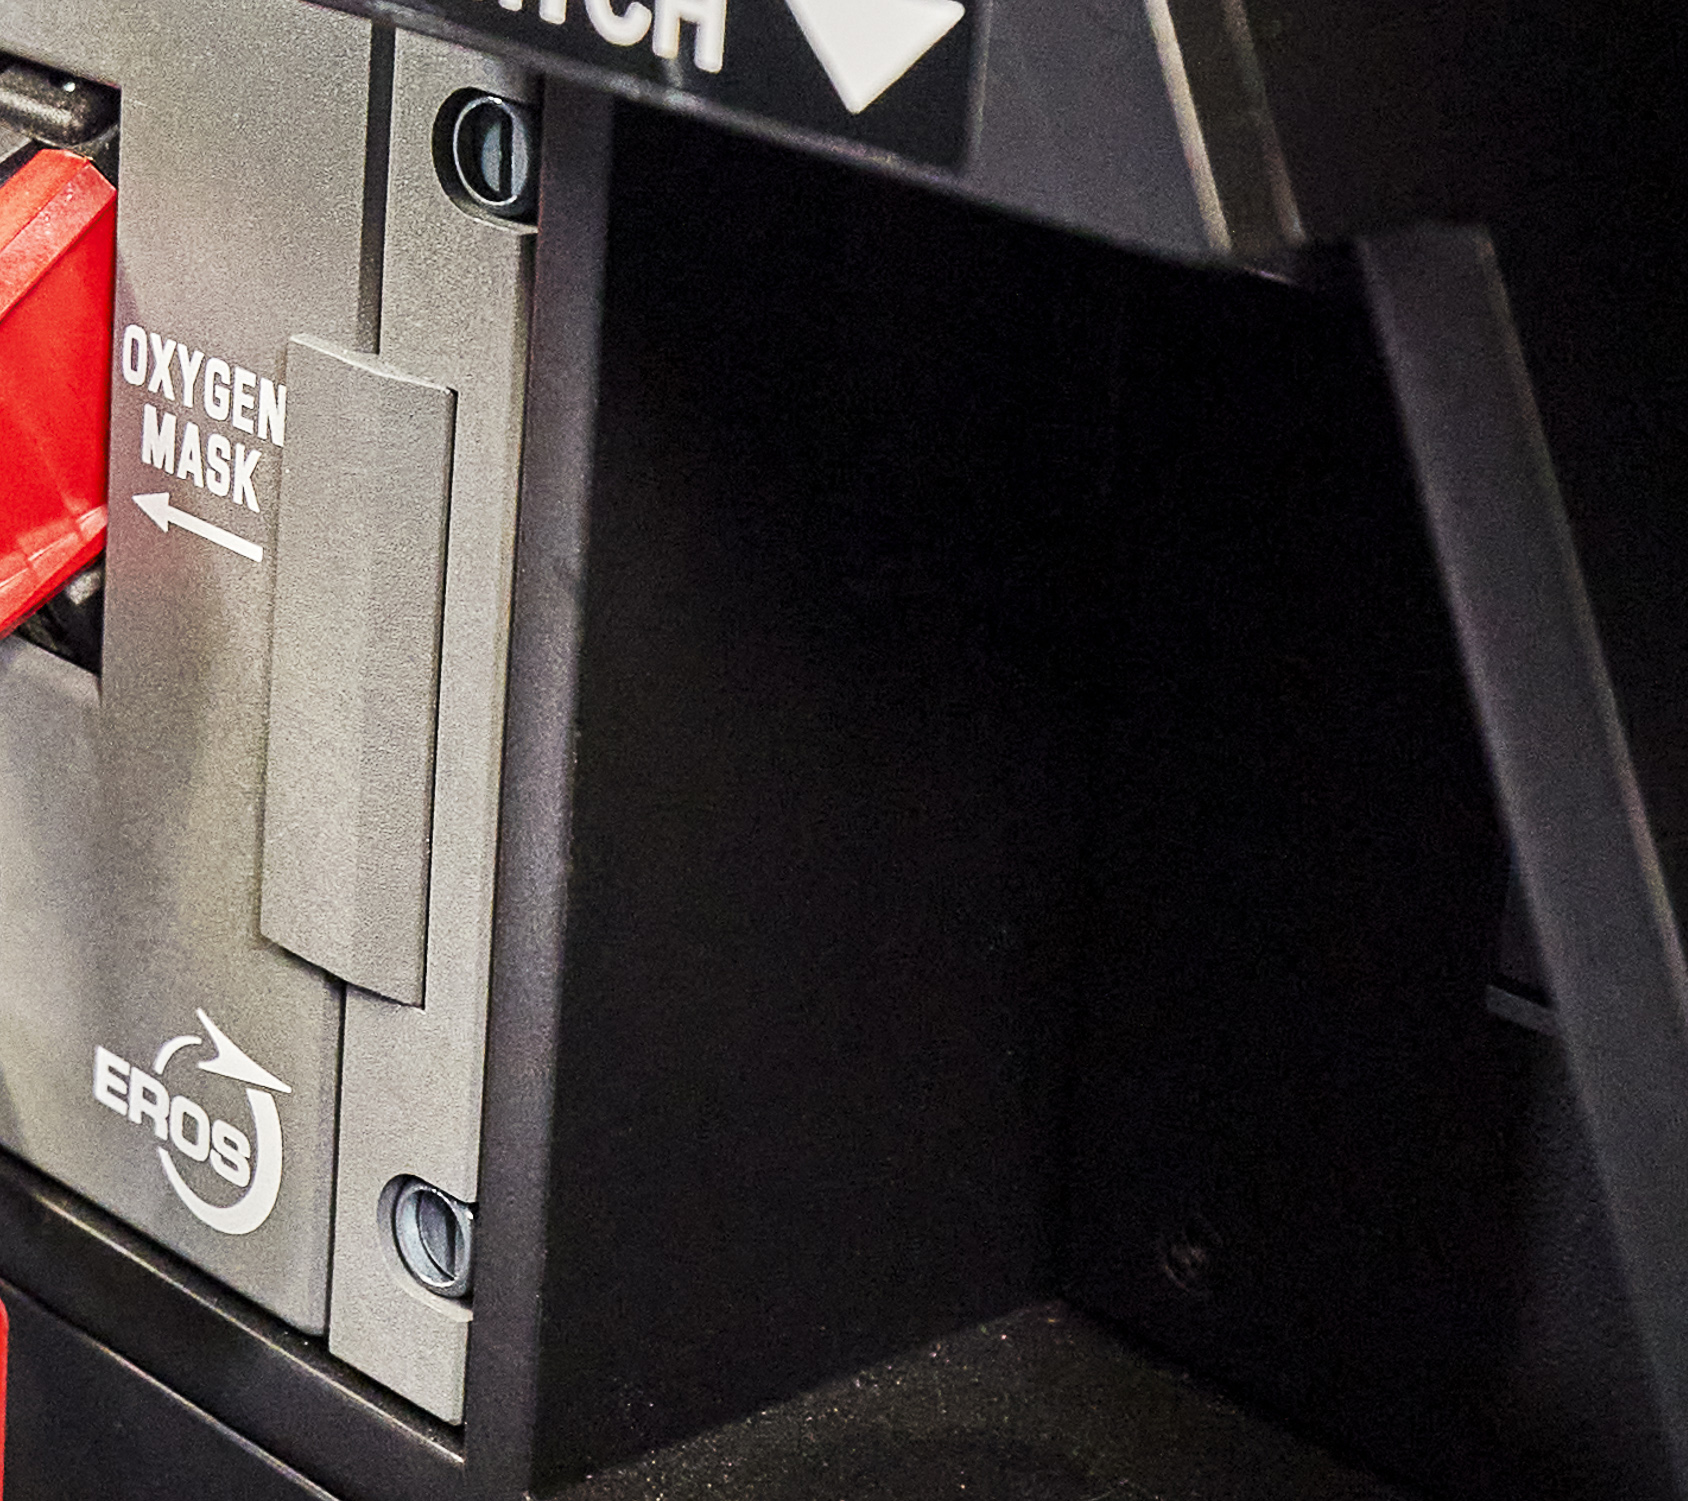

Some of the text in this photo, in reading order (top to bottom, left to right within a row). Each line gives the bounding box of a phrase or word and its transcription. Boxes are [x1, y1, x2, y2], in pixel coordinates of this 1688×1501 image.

[122, 324, 287, 448] OXYGEN
[141, 403, 263, 514] MASK
[93, 1045, 251, 1188] EROS
